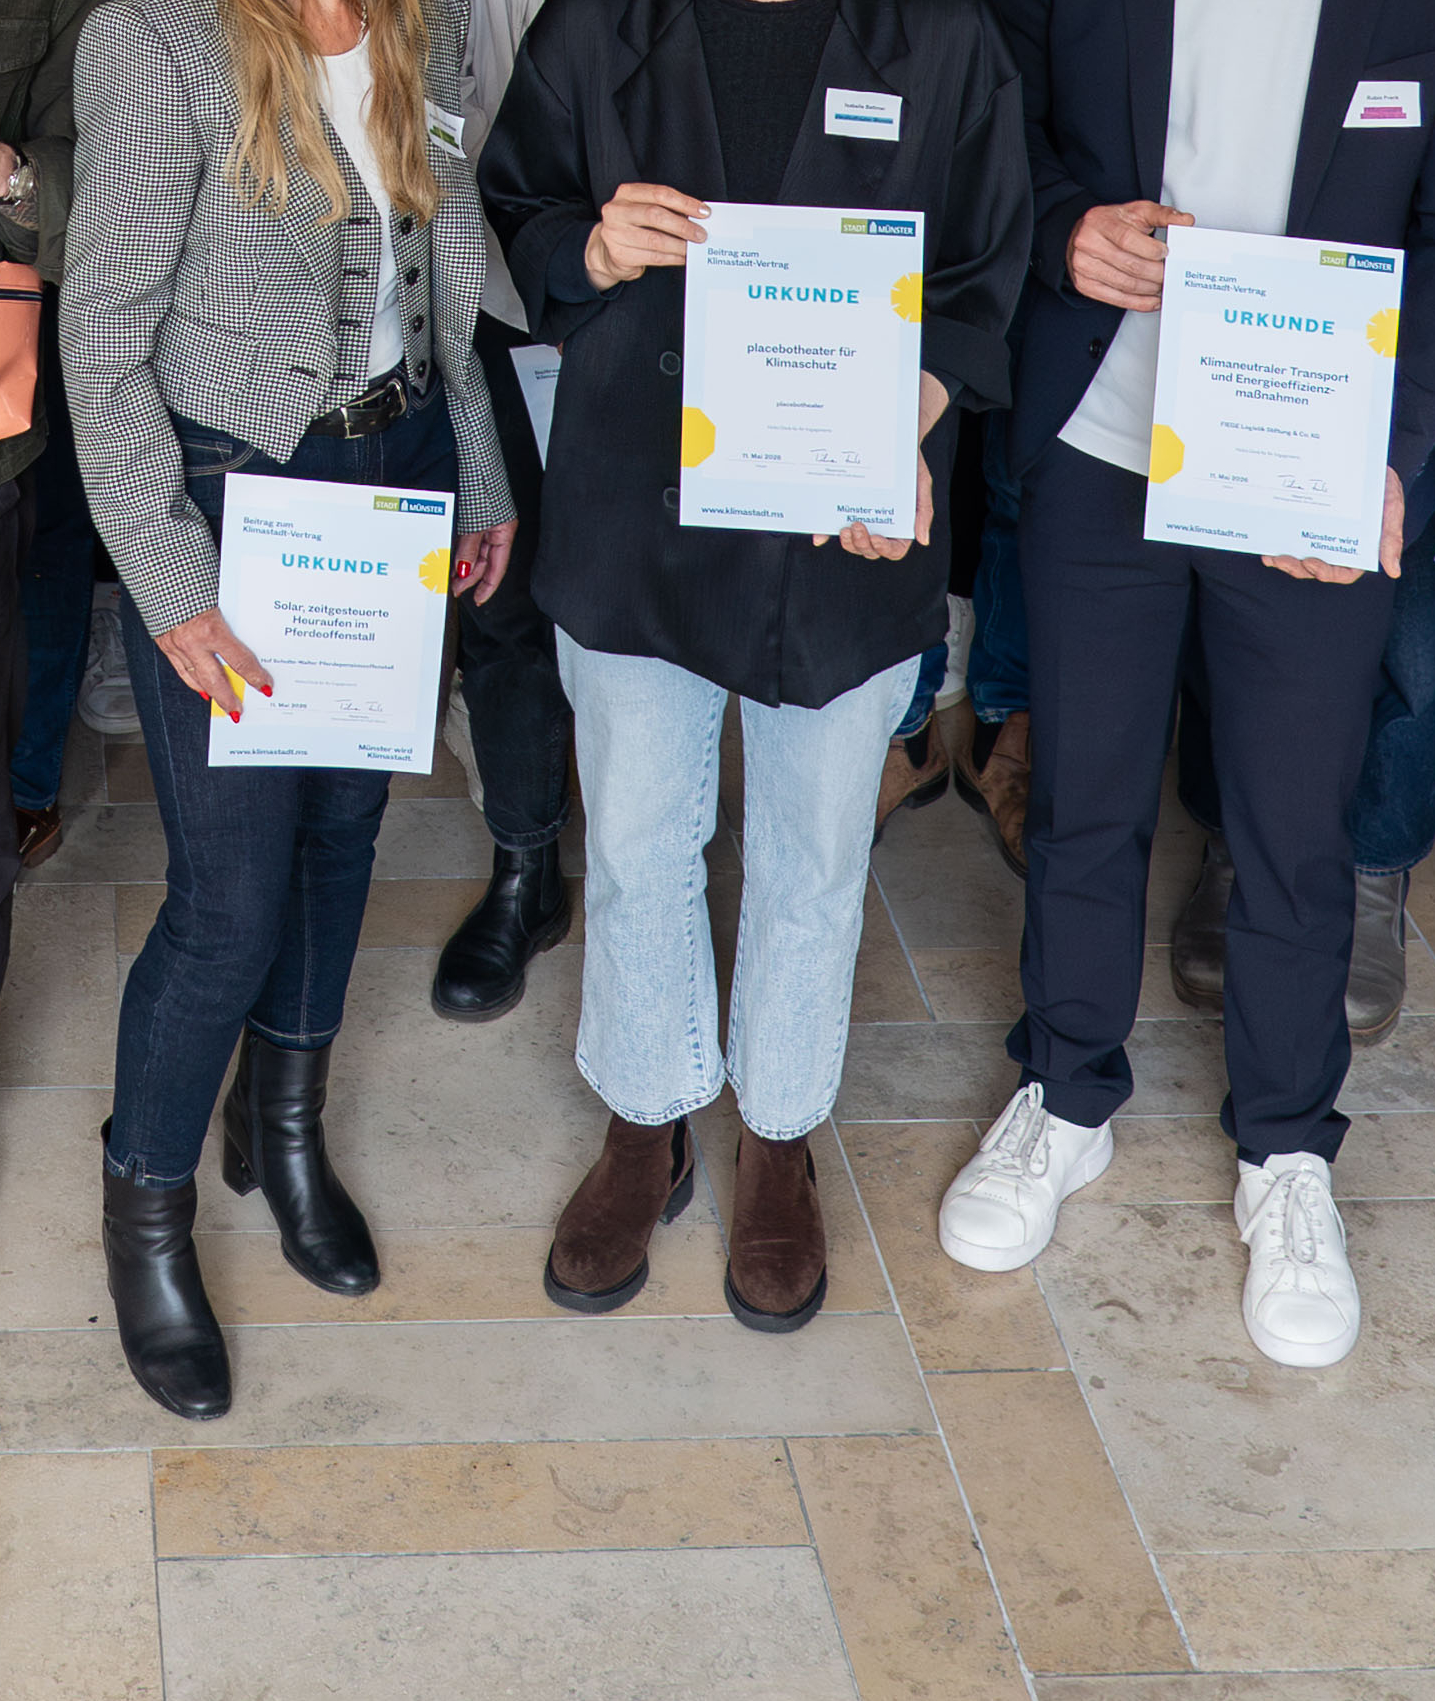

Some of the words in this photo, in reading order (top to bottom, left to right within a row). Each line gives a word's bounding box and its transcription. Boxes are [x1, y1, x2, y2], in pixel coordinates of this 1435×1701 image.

[878, 224, 913, 235] MÜNSTER
[707, 247, 739, 257] Beitrag
[706, 256, 789, 269] Klimastadt-Vertrag
[1356, 258, 1392, 271] MÜNSTER
[1184, 270, 1217, 282] Beitrag
[1217, 275, 1237, 283] zum
[747, 284, 859, 304] URKUNDE
[1184, 279, 1266, 296] Klimastadt-Vertrag
[1223, 308, 1335, 335] URKUNDE
[746, 342, 836, 356] placebotheater
[838, 346, 856, 356] für
[765, 356, 836, 370] Klimaschutz
[1199, 355, 1287, 375] Klimaneutraler
[1289, 366, 1348, 383] Transport
[1210, 372, 1233, 382] und
[1235, 373, 1335, 394] Energieeffizienz-
[1235, 388, 1308, 405] maßnahmen
[409, 502, 443, 513] MÜNSTER
[700, 506, 784, 518] www.klimastadt.ms
[836, 504, 872, 514] Münster
[874, 507, 894, 515] wird
[243, 517, 274, 527] Beitrag
[242, 525, 321, 539] Klimastadt-Vertrag
[1165, 523, 1248, 539] www.klimastadt.ms
[1301, 530, 1336, 542] Münster
[1338, 537, 1359, 546] wird
[281, 553, 388, 575] URKUNDE
[273, 600, 305, 613] Solar,
[307, 604, 389, 617] zeitgesteuerte
[292, 614, 352, 628] Heuraufen
[354, 619, 368, 629] im
[284, 626, 375, 641] Pferdeoffenstall
[358, 743, 391, 752] Münster
